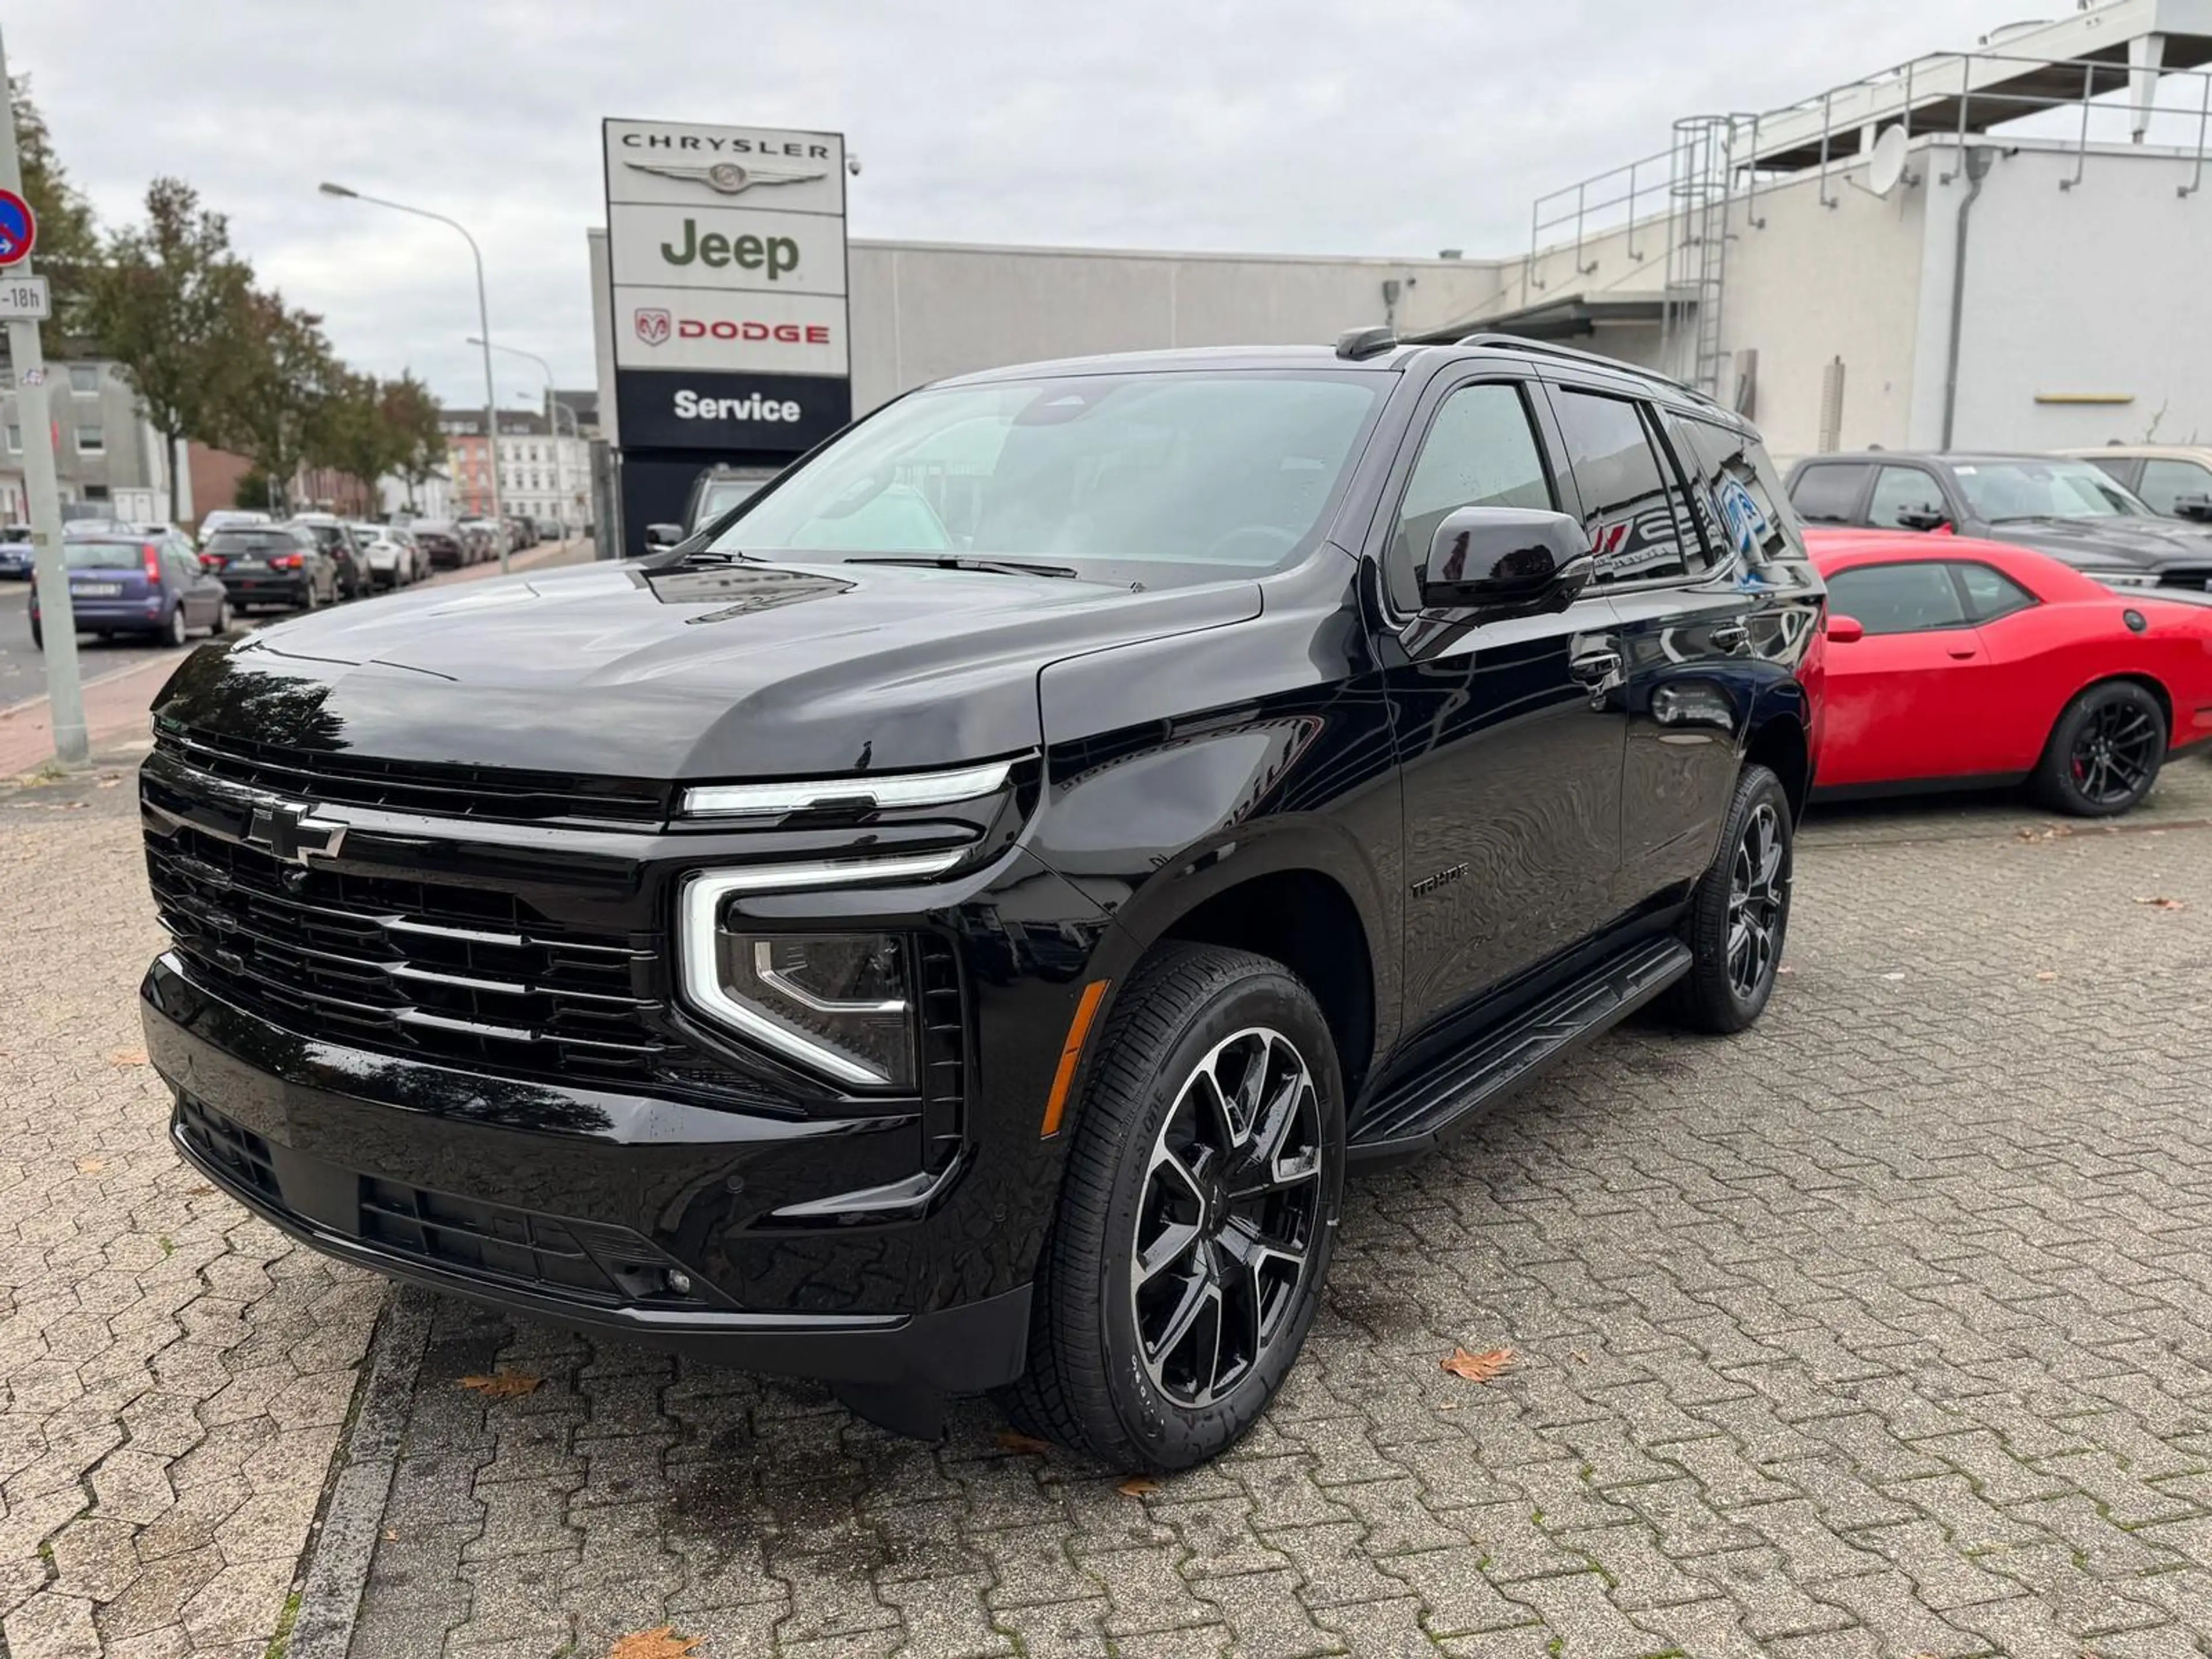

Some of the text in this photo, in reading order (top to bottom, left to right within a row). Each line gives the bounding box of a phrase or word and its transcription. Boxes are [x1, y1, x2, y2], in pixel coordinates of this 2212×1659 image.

[622, 133, 830, 159] CHRYSLER
[661, 218, 800, 281] Jeep
[679, 320, 830, 344] DODGE
[674, 390, 801, 422] Service
